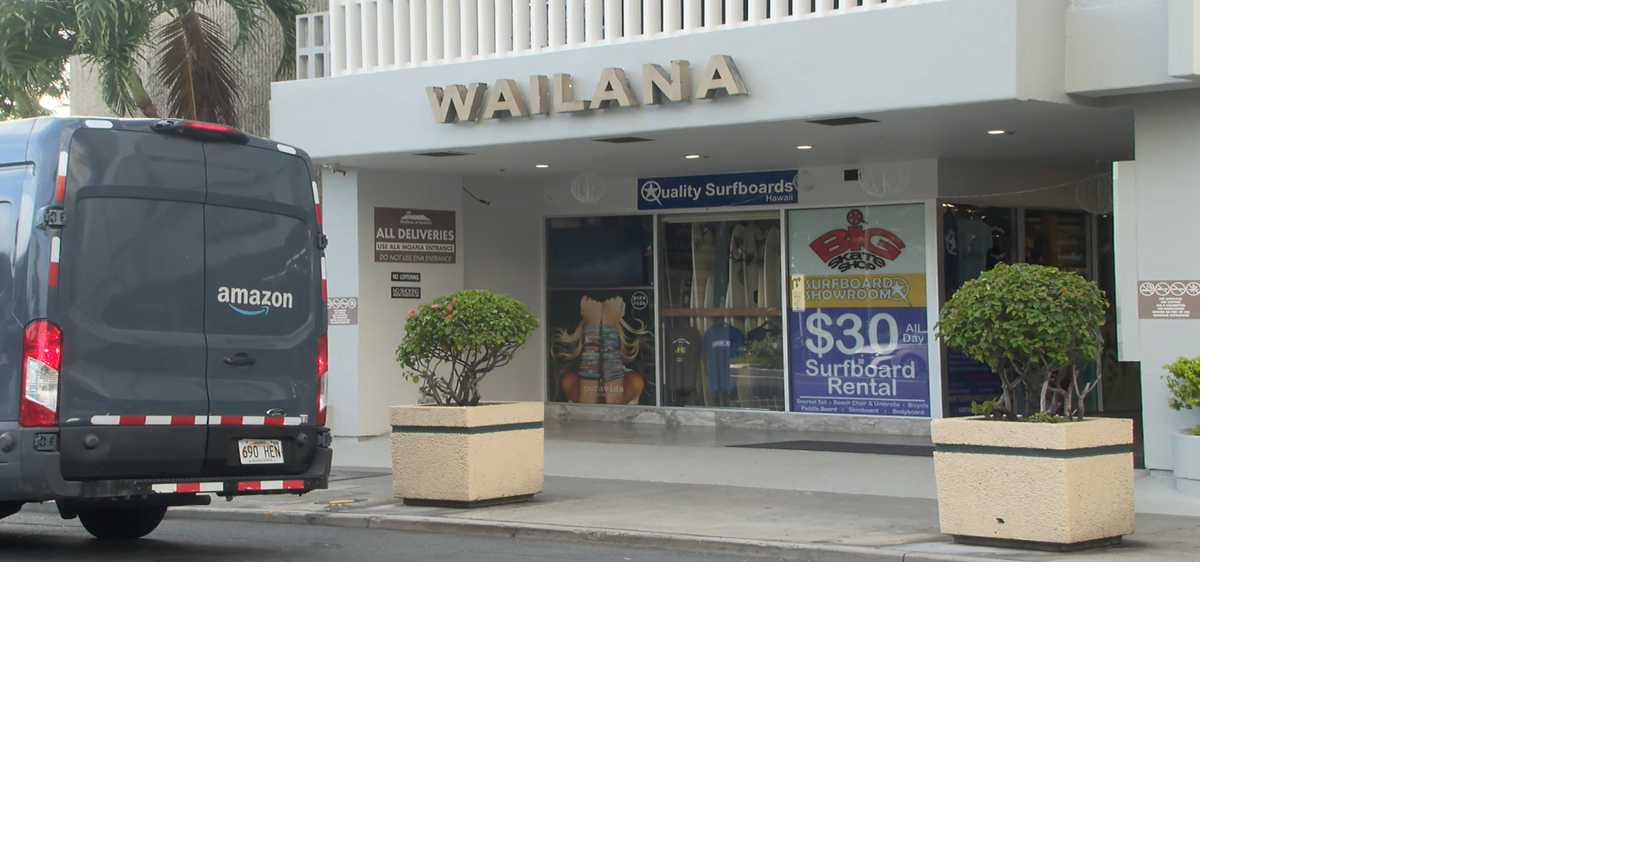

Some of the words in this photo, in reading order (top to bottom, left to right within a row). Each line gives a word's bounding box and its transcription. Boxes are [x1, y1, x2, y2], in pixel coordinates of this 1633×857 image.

[425, 55, 750, 124] WAILANA
[705, 180, 794, 196] Surfboards
[765, 194, 793, 202] Hawaii
[376, 227, 395, 239] ALL
[398, 228, 454, 241] DELIVERIES
[805, 277, 893, 290] SURFBOARD
[217, 286, 293, 309] amazon
[805, 289, 892, 301] SHOWROOM
[805, 307, 899, 358] $30
[905, 323, 920, 333] All
[902, 333, 925, 346] Day
[805, 359, 915, 379] Surfboard
[827, 377, 897, 396] Rental
[242, 445, 259, 458] 690
[263, 445, 281, 458] HEN
